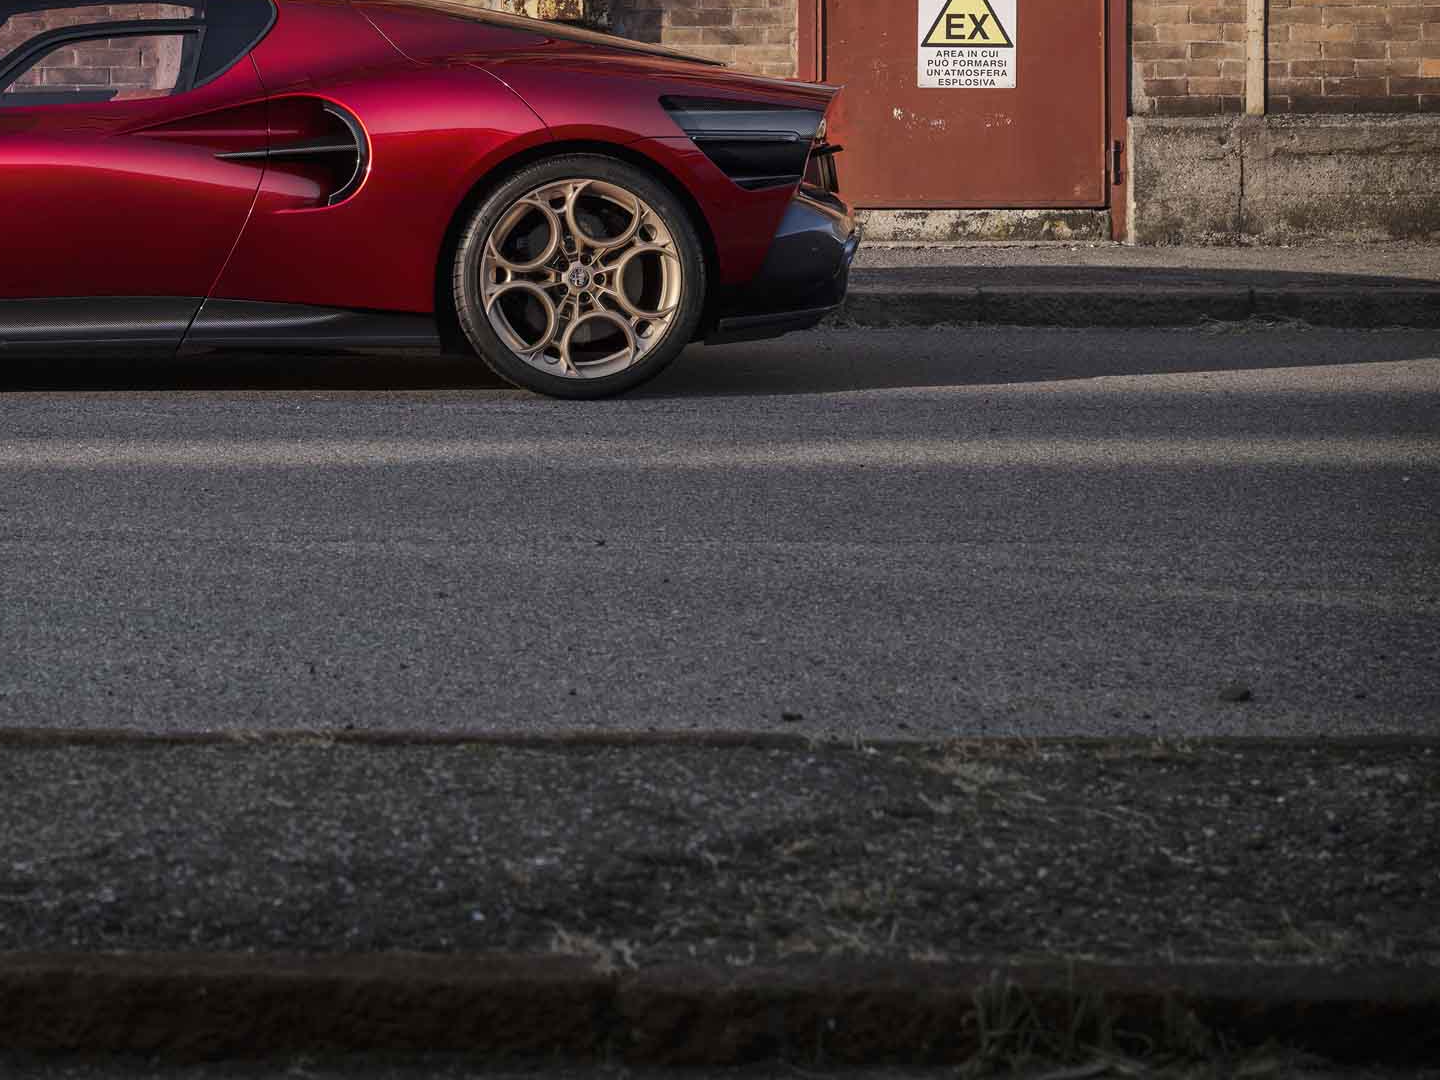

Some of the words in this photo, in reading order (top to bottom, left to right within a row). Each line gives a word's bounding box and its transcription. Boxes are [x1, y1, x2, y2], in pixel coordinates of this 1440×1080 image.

[945, 13, 990, 40] EX
[935, 50, 964, 58] AREA
[967, 50, 978, 58] IN
[981, 50, 999, 58] CUI
[927, 58, 949, 68] PUÒ
[952, 59, 1007, 68] FORMARSI
[926, 69, 1008, 77] UN'ATMOSFERA
[938, 78, 996, 87] ESPLOSIVA
